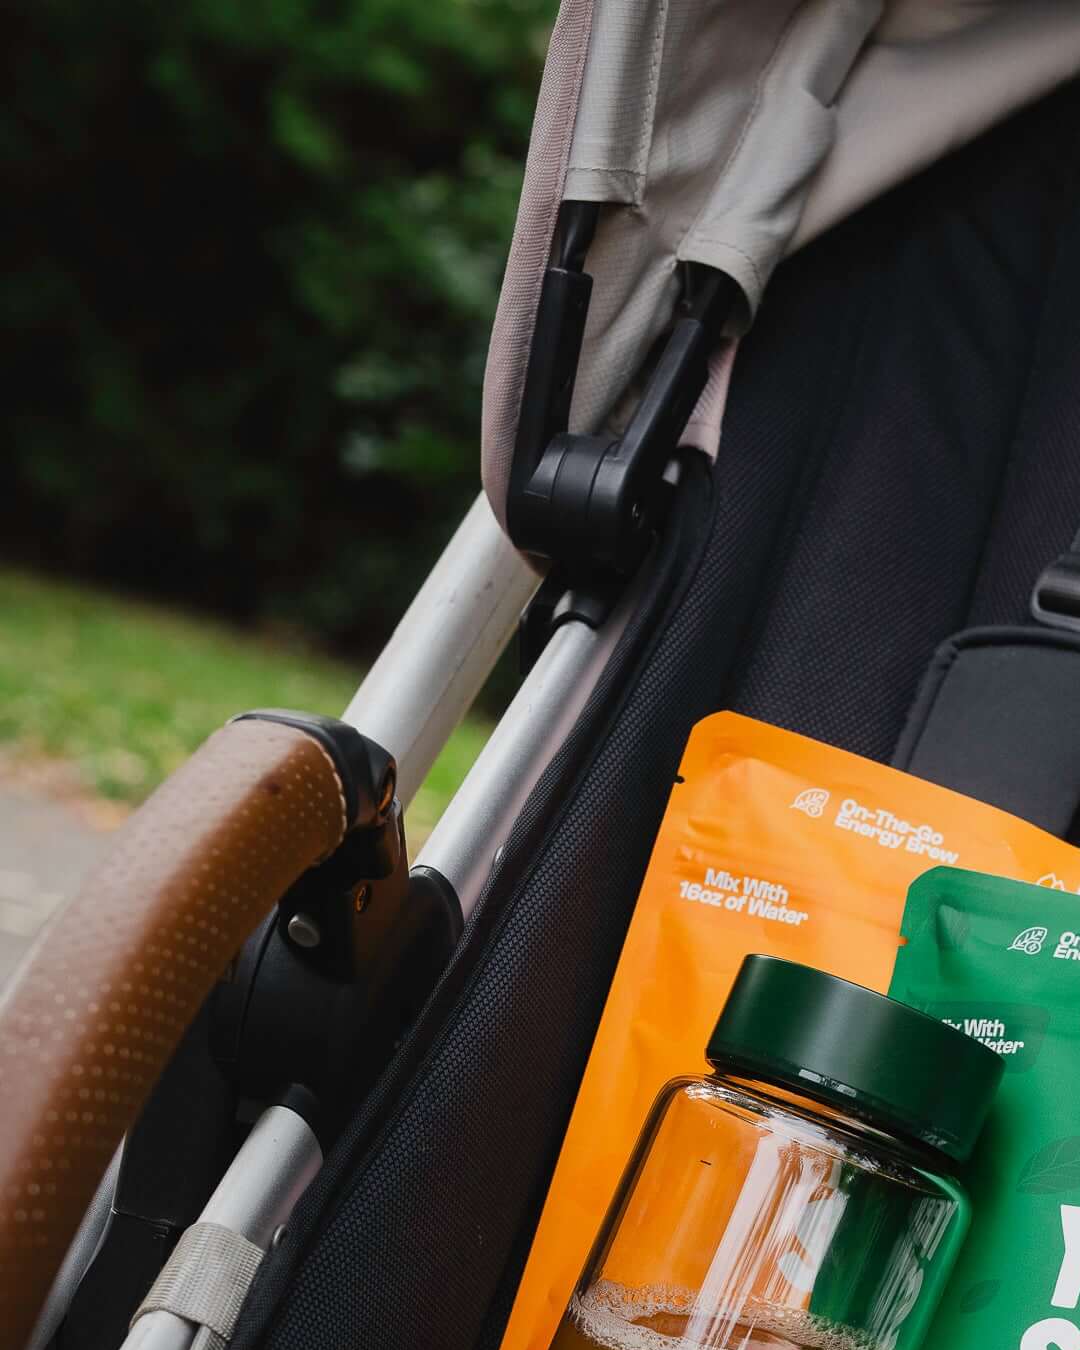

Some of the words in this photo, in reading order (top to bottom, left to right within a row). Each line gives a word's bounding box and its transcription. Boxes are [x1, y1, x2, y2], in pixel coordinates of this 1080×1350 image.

[834, 814, 904, 849] Energy
[905, 832, 959, 864] Brew
[839, 799, 944, 845] On-The-Go
[679, 881, 723, 907] 16oz
[726, 894, 747, 912] of
[748, 897, 809, 925] Water
[704, 868, 738, 890] Mix
[743, 876, 789, 904] With
[963, 1018, 1005, 1037] With
